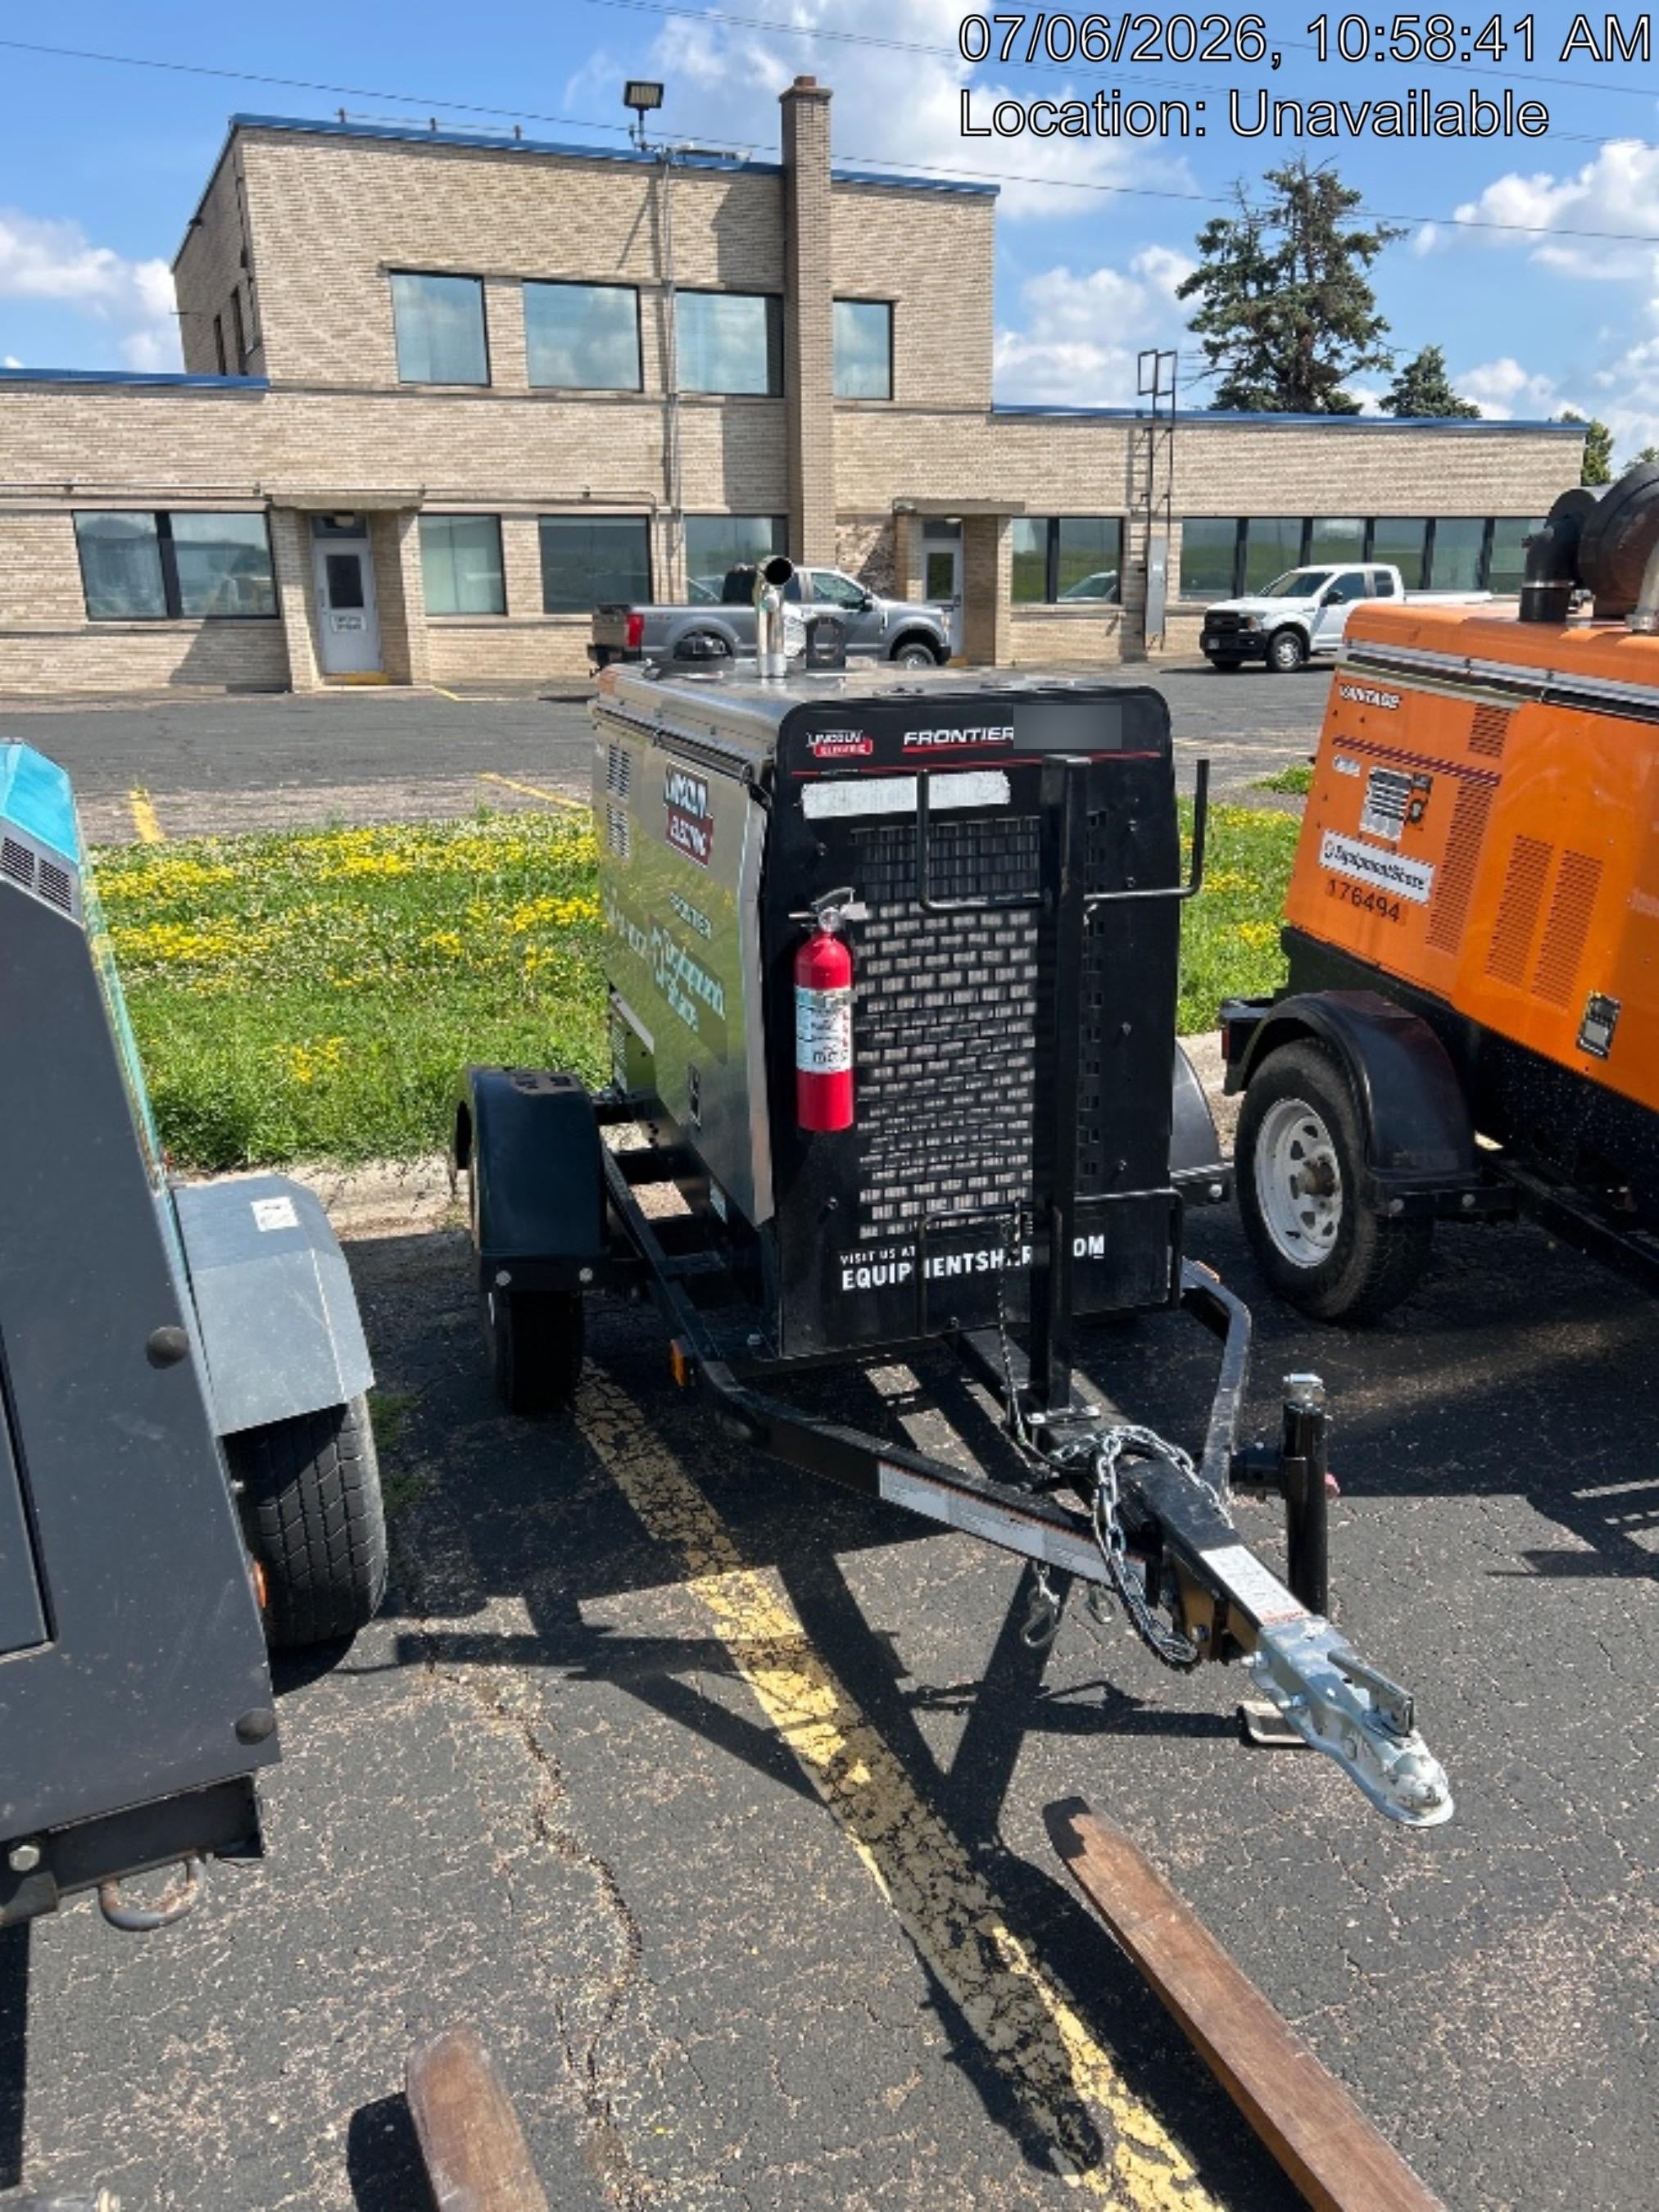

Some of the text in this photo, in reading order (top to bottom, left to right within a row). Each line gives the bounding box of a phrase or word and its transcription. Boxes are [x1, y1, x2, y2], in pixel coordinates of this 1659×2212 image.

[903, 726, 1014, 746] FRONTIER
[1327, 878, 1401, 923] 176494
[840, 1250, 877, 1266] VISIT
[879, 1248, 896, 1260] US
